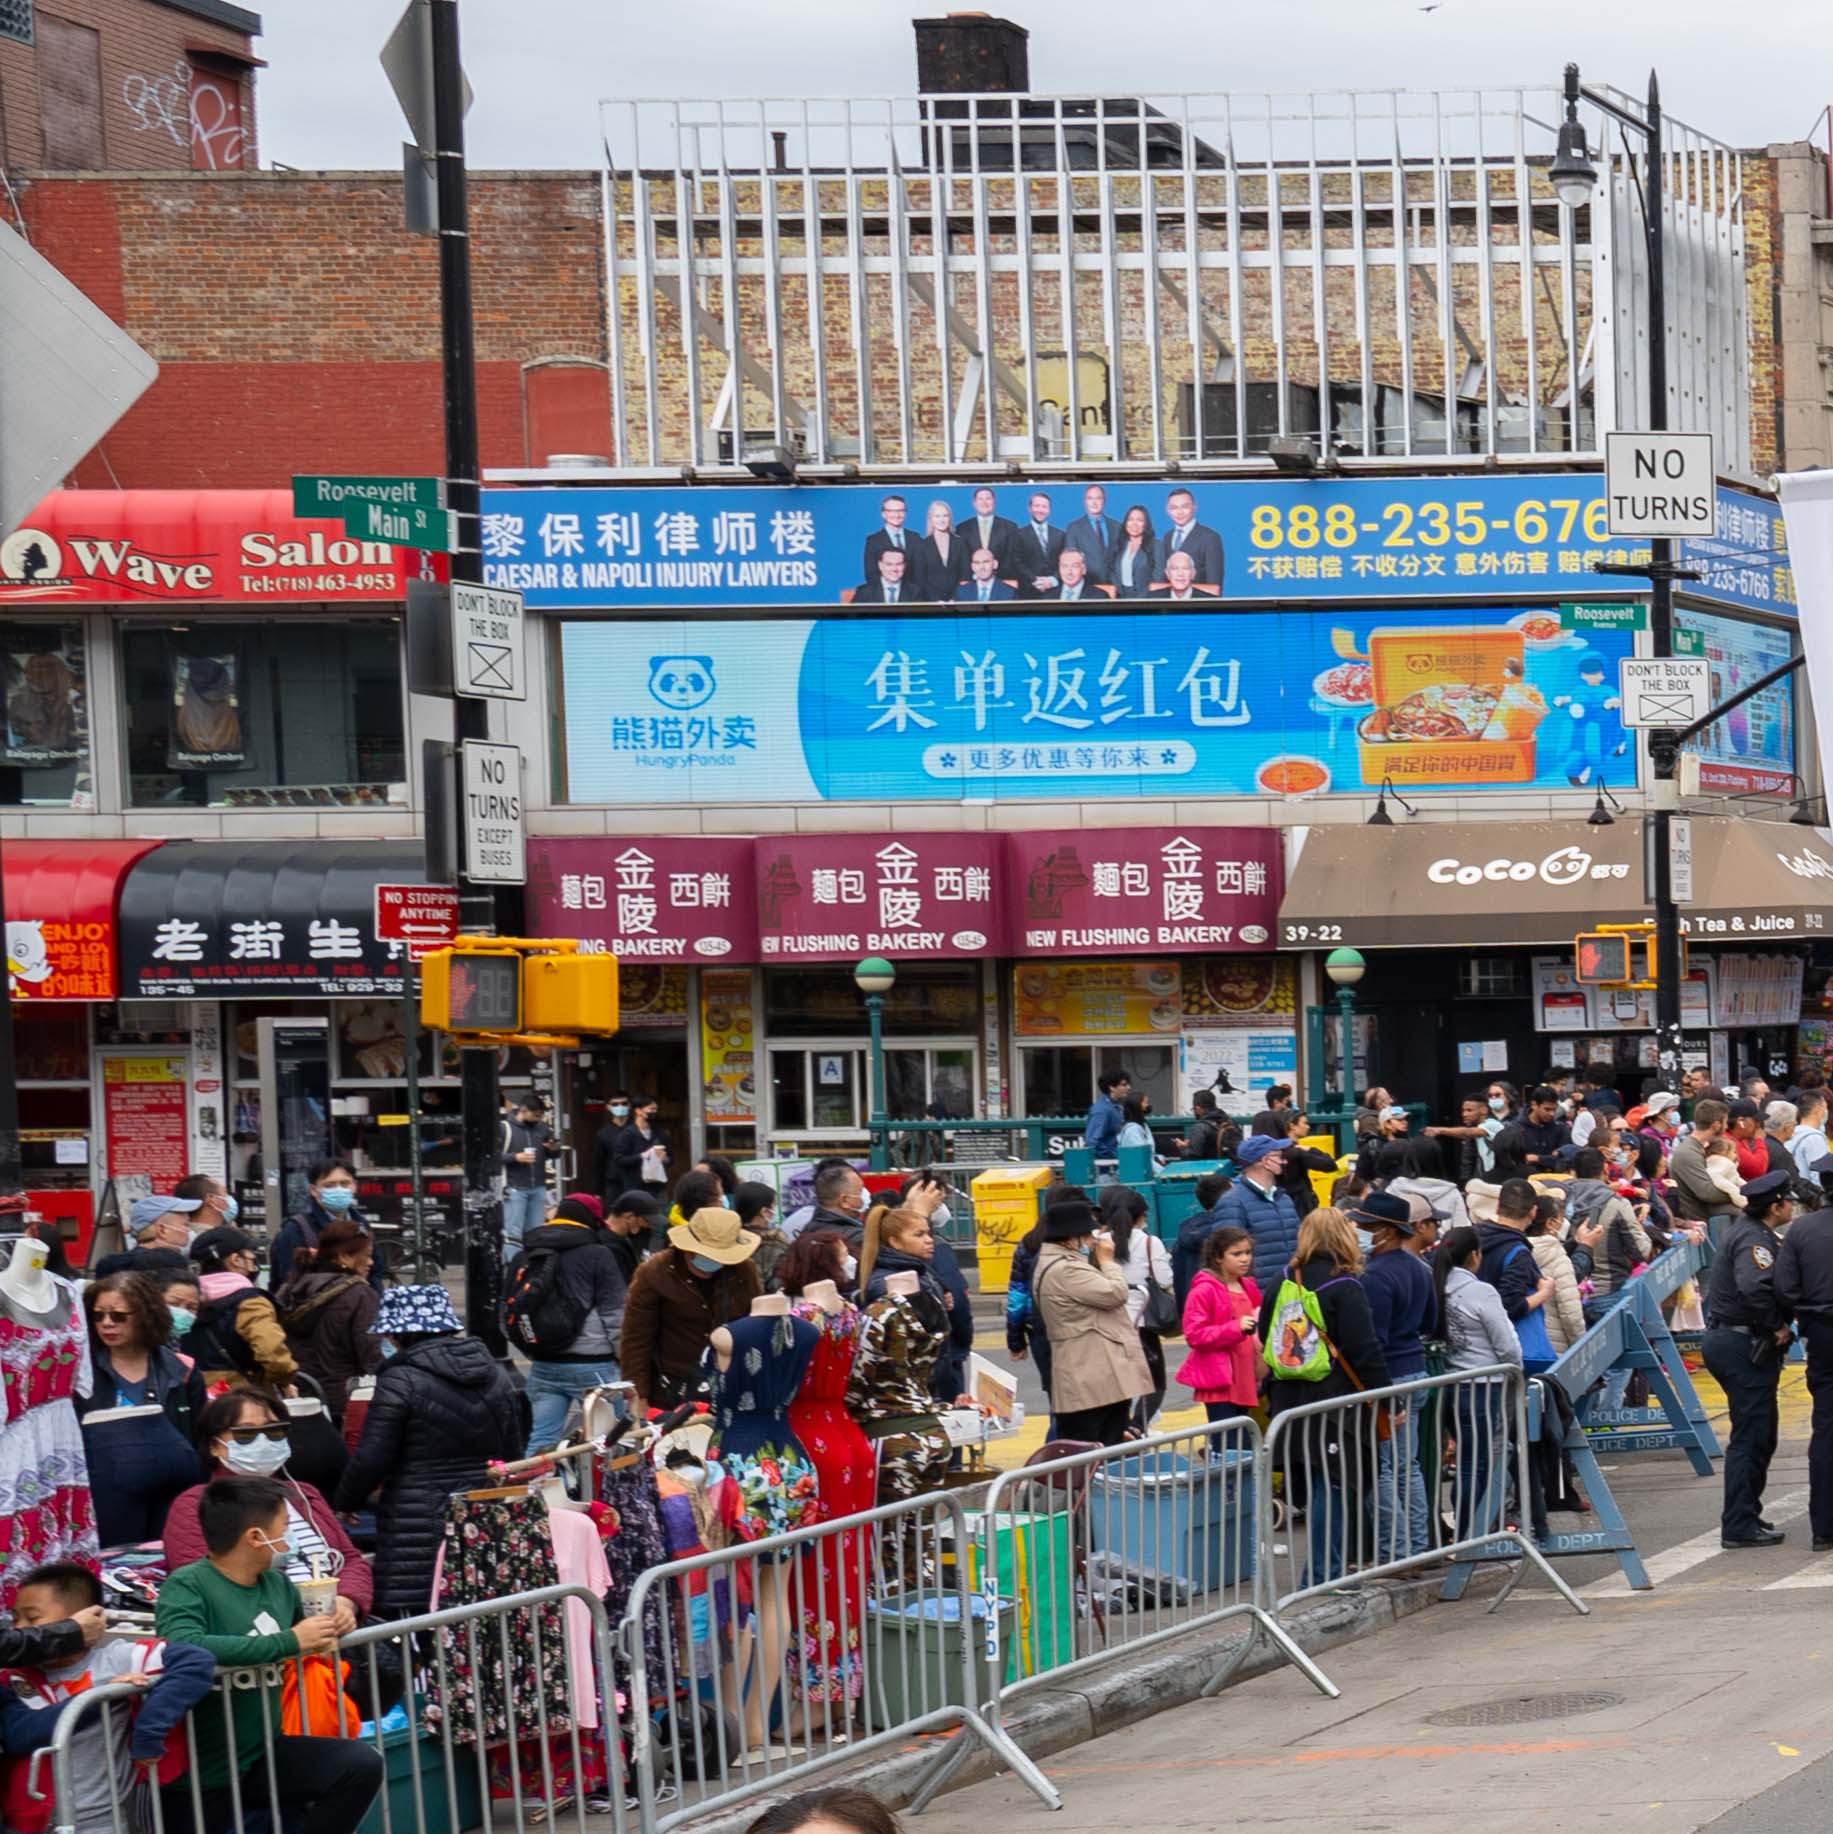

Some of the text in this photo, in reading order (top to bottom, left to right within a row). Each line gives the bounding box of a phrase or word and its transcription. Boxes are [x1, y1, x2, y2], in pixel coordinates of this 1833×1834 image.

[1635, 448, 1684, 478] NO
[317, 480, 417, 502] Roosevelt
[1613, 495, 1708, 521] TURNS
[369, 504, 427, 540] Main St
[1250, 499, 1607, 549] 888-235-676
[482, 511, 816, 557] 黎保利律师楼
[240, 532, 393, 567] Salon
[66, 540, 213, 590] Wave
[483, 561, 817, 589] CAESAR & NAPOLI INJURY LAWYERS
[457, 591, 519, 617] DON'T BLOCK
[1574, 607, 1635, 621] Roosevelt
[470, 618, 510, 641] THE BOX
[1627, 664, 1703, 677] DON'T BLOCK
[866, 645, 1251, 732] 集单返红包
[1642, 679, 1690, 691] THE BOX
[612, 716, 757, 749] 熊猫外卖
[481, 759, 505, 785] NO
[635, 754, 736, 768] HungryPanda
[469, 793, 520, 820] TURNS
[477, 828, 513, 846] EXCEPT
[480, 849, 512, 867] BUSES
[1428, 856, 1537, 886] CoCo
[384, 892, 458, 906] NO STOPPIN
[399, 908, 453, 921] ANYTIME
[1695, 916, 1727, 932] Tea
[1731, 916, 1745, 932] &
[1750, 914, 1796, 932] Juice
[41, 923, 110, 940] ENJO
[152, 918, 403, 960] 老街生
[1026, 929, 1056, 948] NEW
[1061, 927, 1150, 946] FLUSHING
[1157, 925, 1233, 944] BAKERY
[1285, 924, 1343, 942] 39-22
[612, 938, 687, 955] BAKERY
[783, 934, 860, 953] FLUSHING
[867, 933, 945, 951] BAKERY
[140, 984, 195, 995] 135-45
[824, 1061, 838, 1076] A
[1588, 1408, 1667, 1423] POLICE DE
